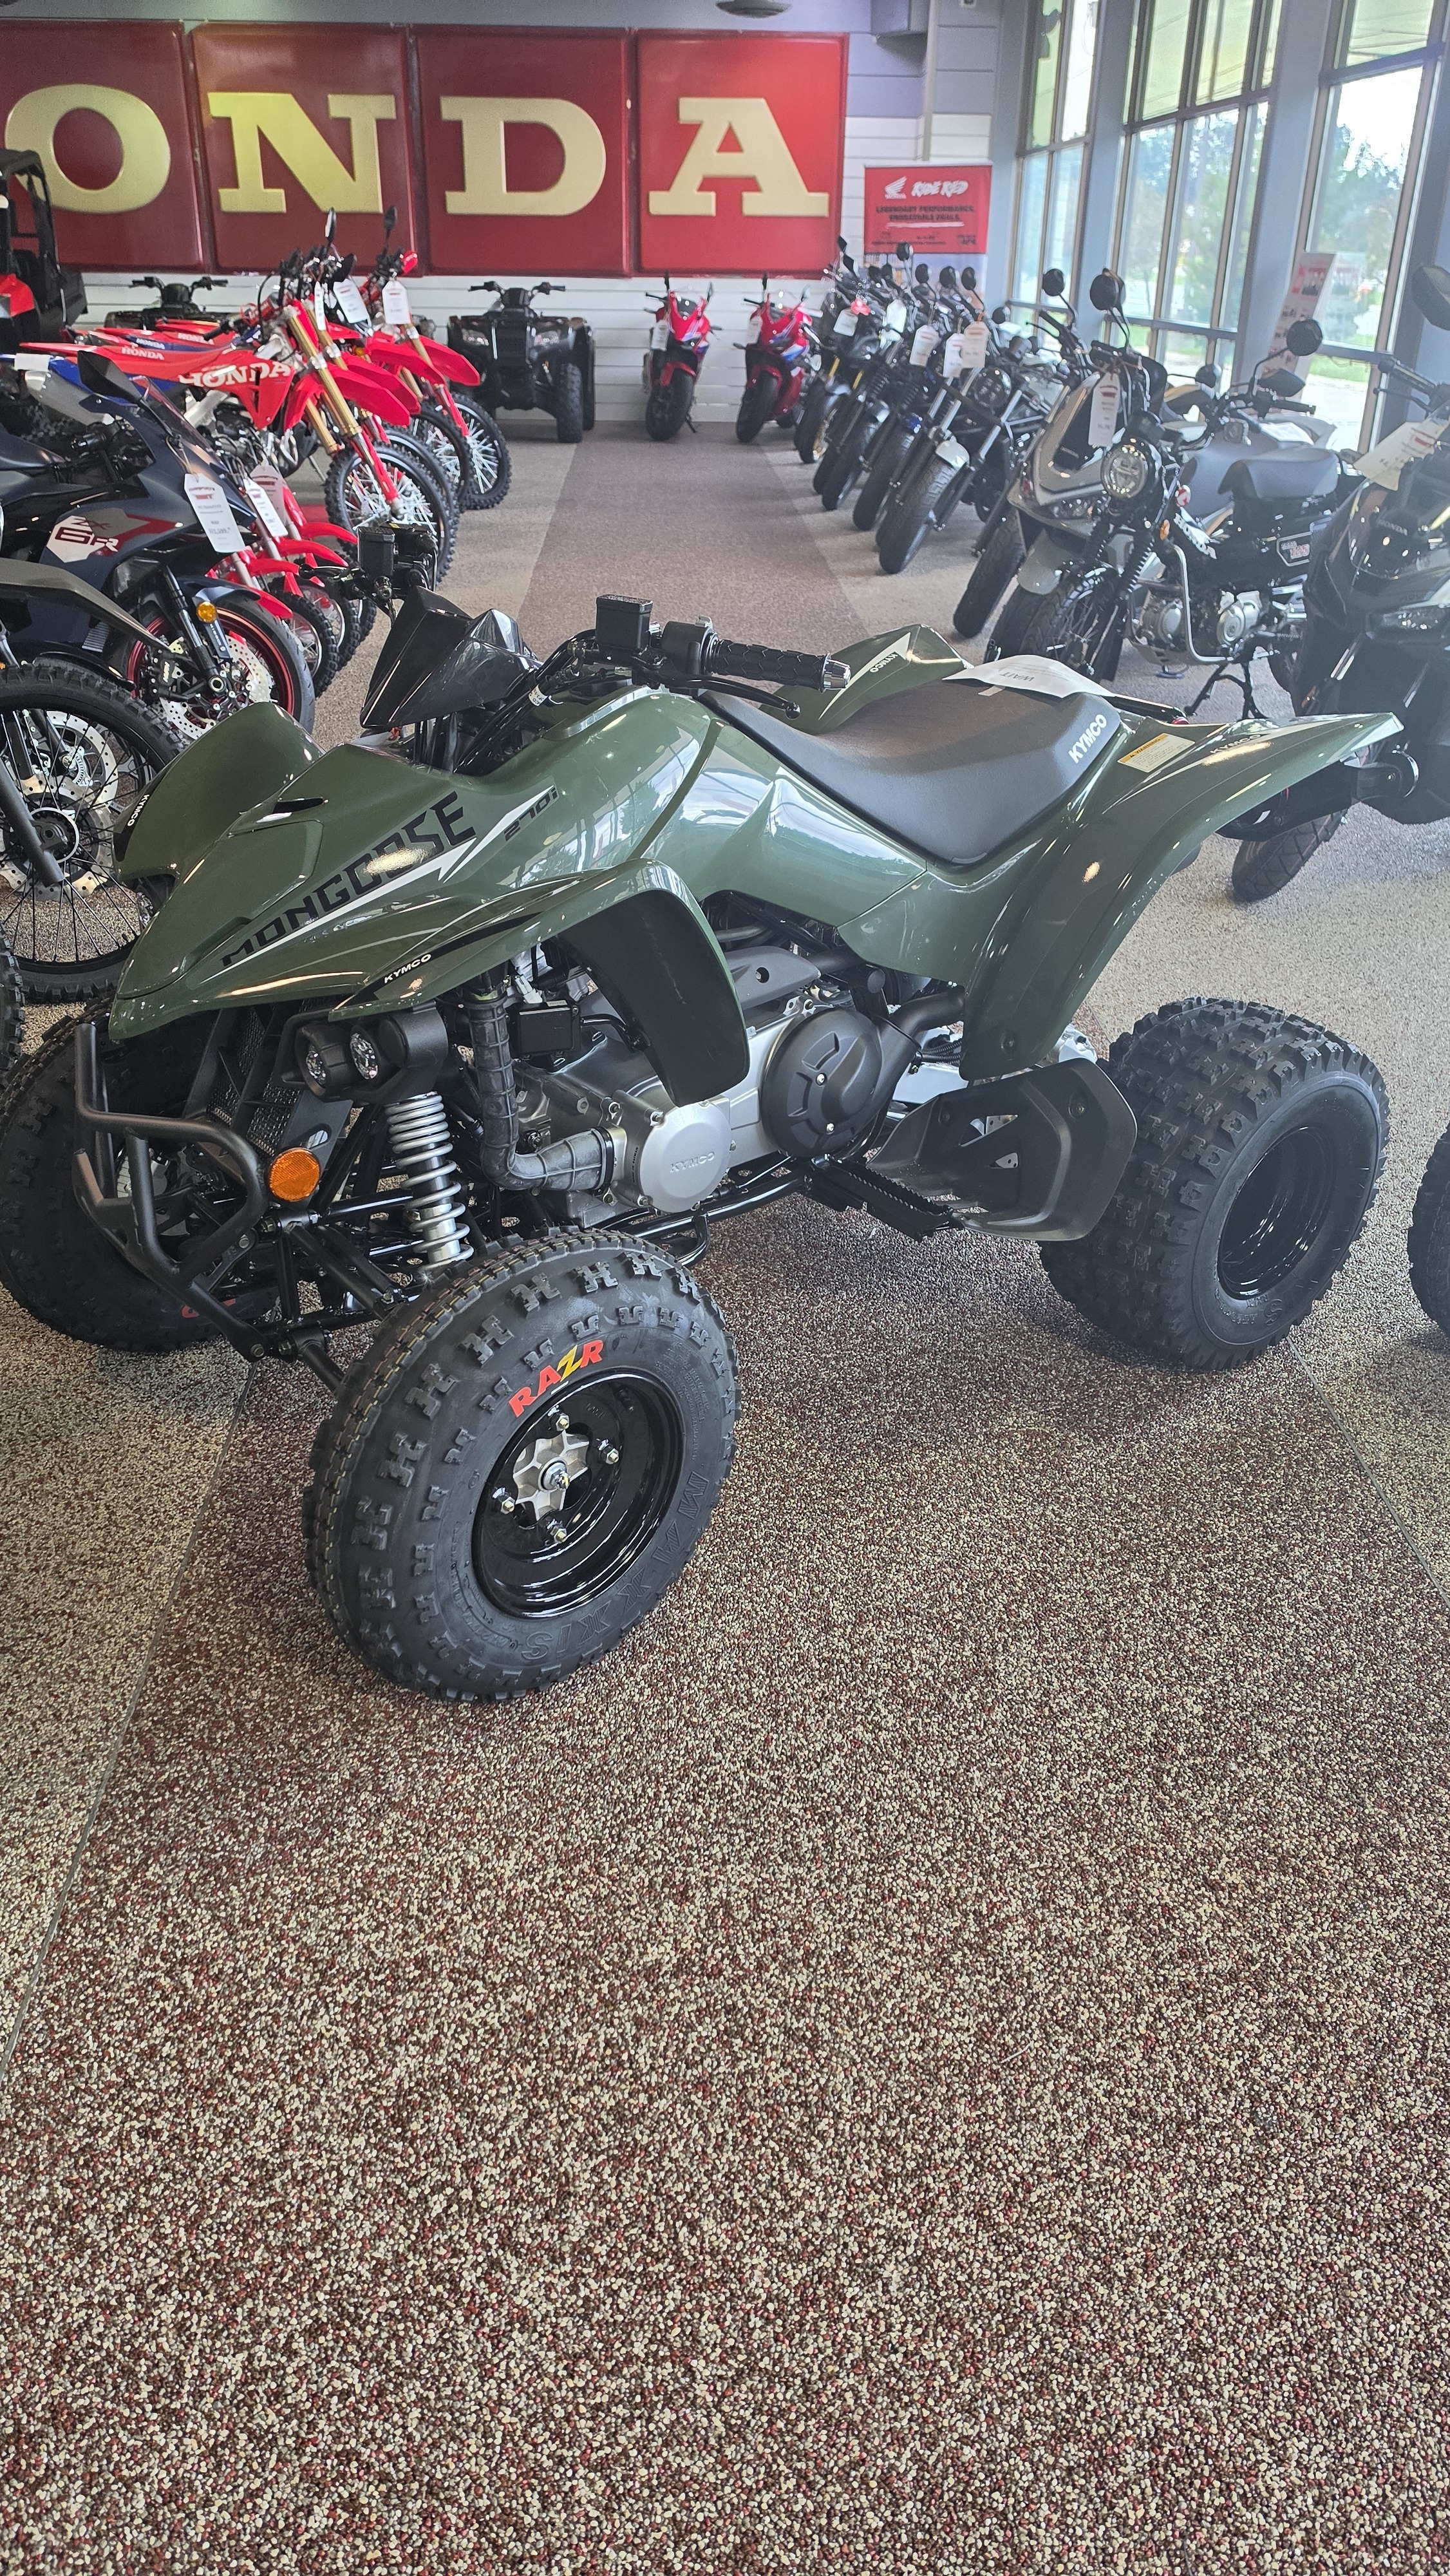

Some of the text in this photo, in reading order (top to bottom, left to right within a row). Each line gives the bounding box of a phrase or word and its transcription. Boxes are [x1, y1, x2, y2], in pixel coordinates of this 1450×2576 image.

[911, 180, 968, 197] RIDE RED
[120, 346, 165, 361] HONDA
[136, 337, 165, 350] HONDA
[178, 361, 291, 388] HONDA
[1377, 520, 1408, 536] HONDA
[869, 653, 899, 673] KYMCO
[999, 672, 1035, 683] WAIT
[1068, 714, 1107, 764] KYMCO
[1210, 734, 1261, 753] KYMCO
[127, 793, 150, 827] KYMCO
[504, 787, 558, 842] 270i
[220, 790, 478, 967] MONGOOSE
[384, 954, 431, 984] KYMCO
[670, 1151, 715, 1173] KYMCO
[507, 1339, 604, 1418] RAZR
[520, 1471, 710, 1661] MAXXIS
